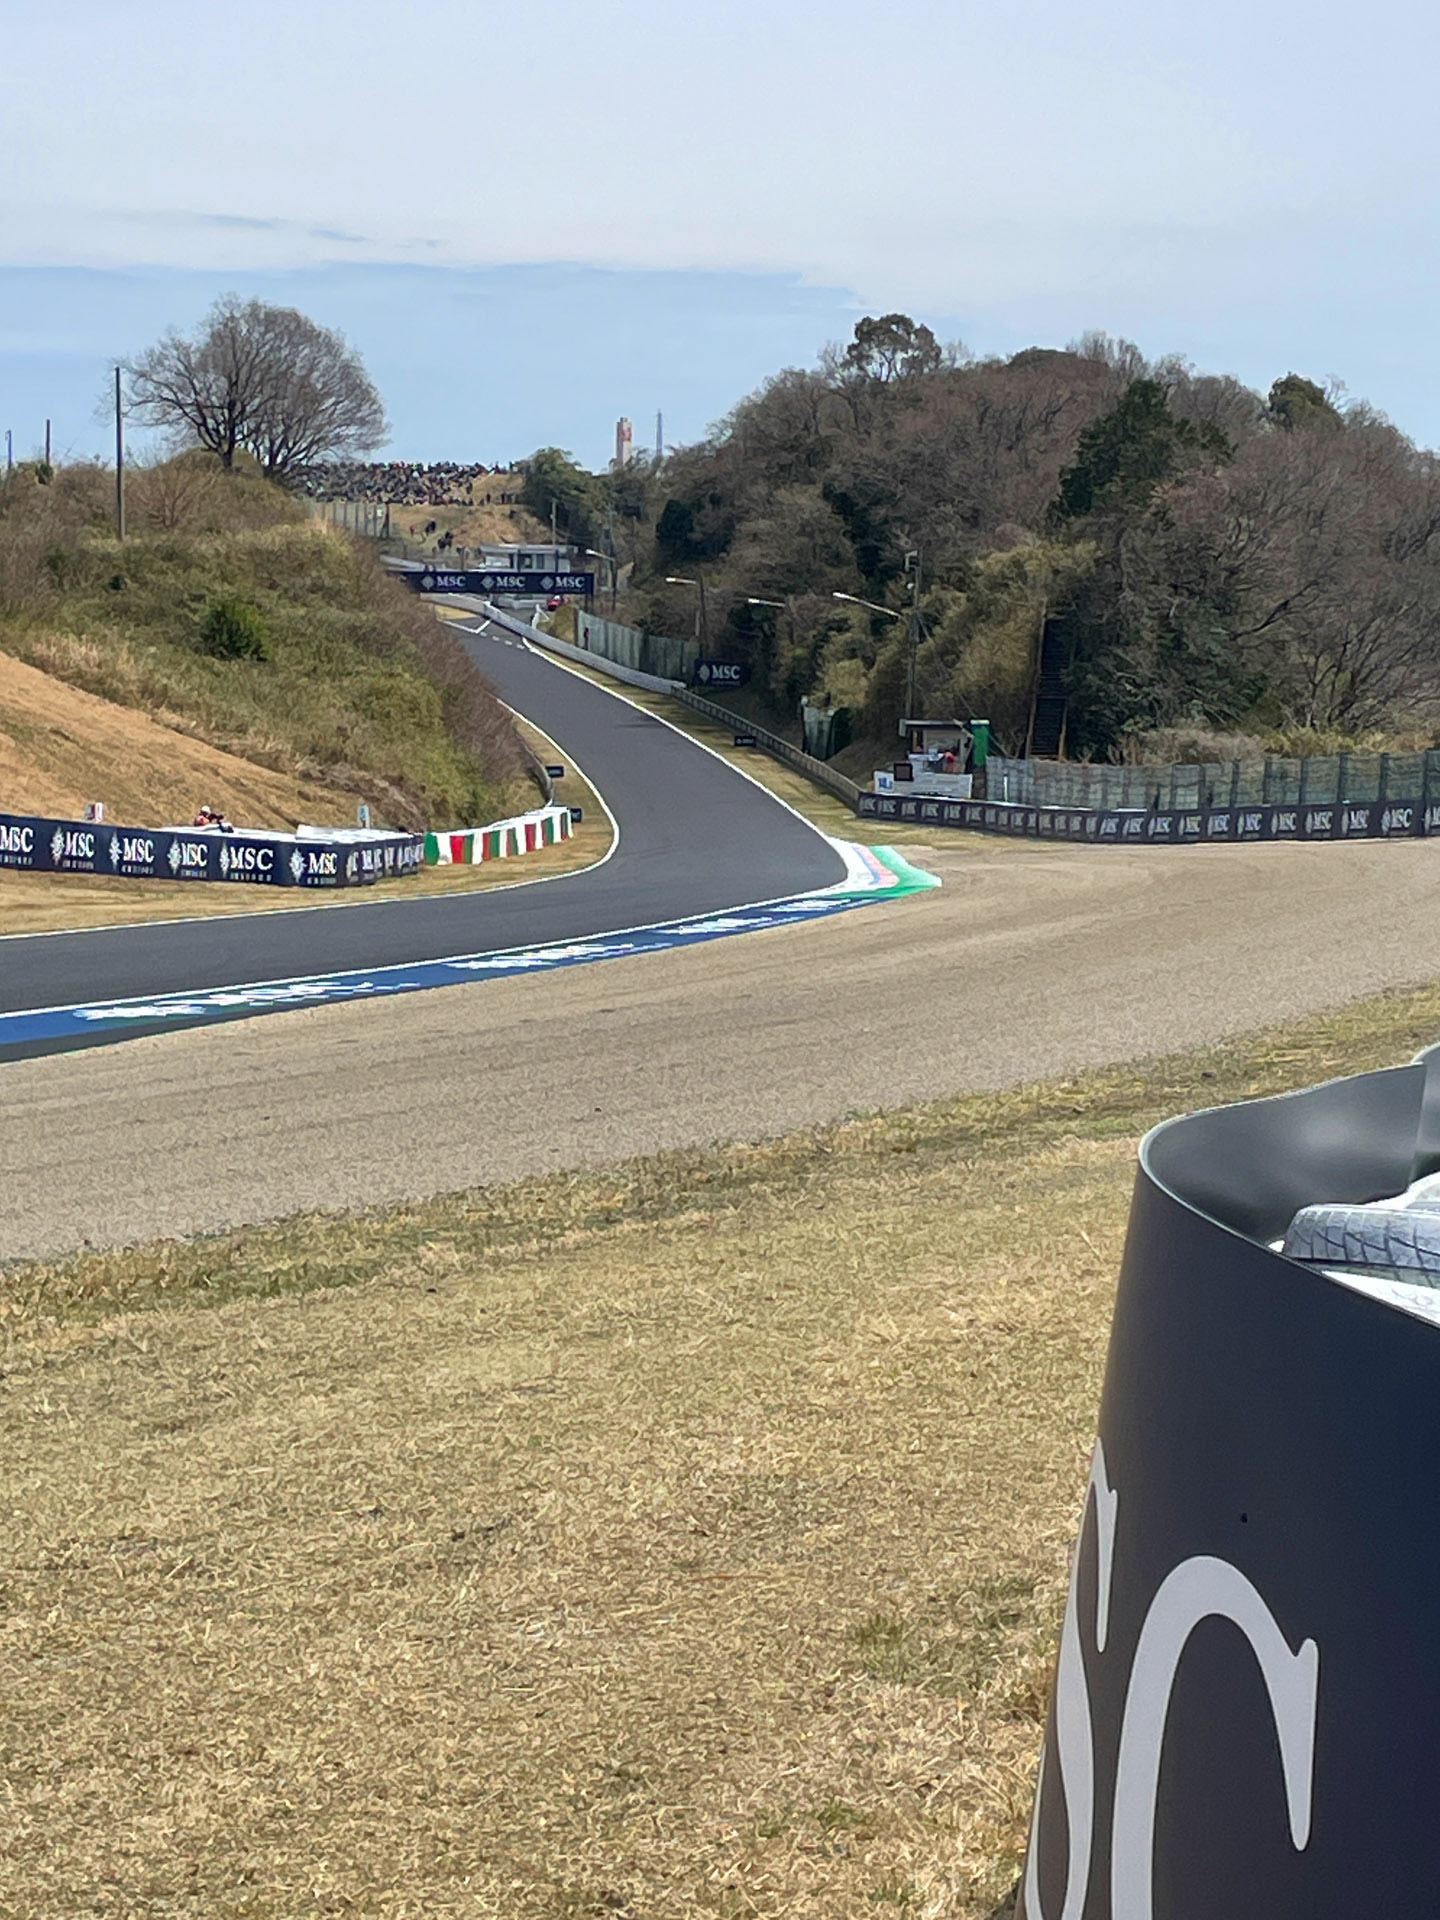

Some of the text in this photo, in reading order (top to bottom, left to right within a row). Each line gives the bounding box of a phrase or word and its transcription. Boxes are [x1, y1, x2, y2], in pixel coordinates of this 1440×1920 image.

[712, 665, 740, 680] MSC
[65, 831, 95, 857] MSC
[123, 838, 154, 862] MSC
[181, 842, 208, 867] MSC
[230, 846, 273, 871] MSC
